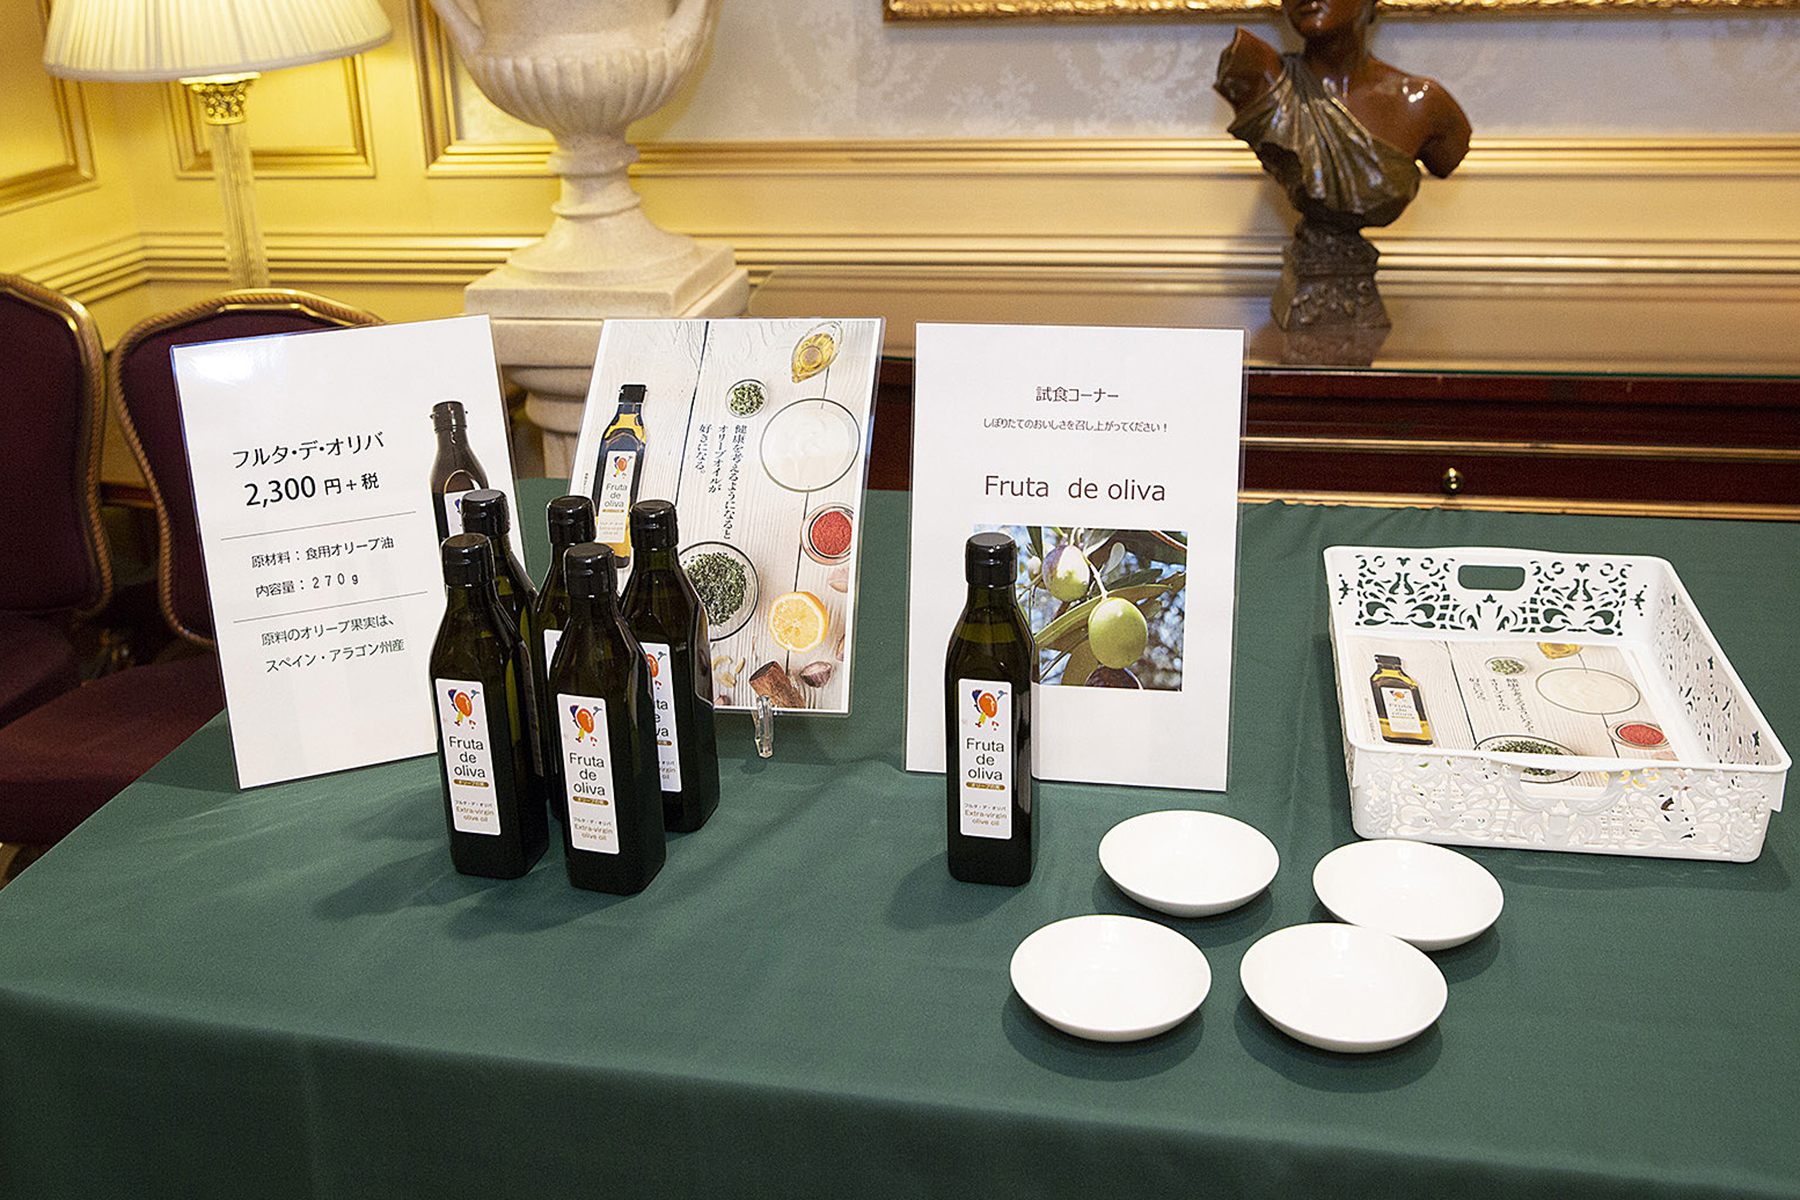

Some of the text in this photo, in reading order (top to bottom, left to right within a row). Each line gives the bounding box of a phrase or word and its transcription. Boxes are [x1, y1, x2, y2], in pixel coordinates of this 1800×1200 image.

[1035, 386, 1119, 403] 試食コーナー
[233, 431, 384, 469] フルタ・デ・オリバ
[695, 423, 713, 475] 好きになる。
[708, 424, 729, 494] オリーブオイルが
[606, 483, 628, 491] Fruta
[723, 424, 748, 540] 健康を考えるようになると
[985, 475, 1165, 501] Fruta de oliva
[244, 475, 316, 508] 2,300
[604, 500, 624, 508] oliva
[261, 614, 395, 646] 原料のオリーブ果実は、
[266, 638, 405, 673] スペイン・アラゴン州産
[449, 736, 484, 751] Fruta
[966, 738, 1005, 753] Fruta
[460, 751, 477, 764] de
[569, 752, 605, 768] Fruta
[976, 753, 995, 766] de
[454, 765, 486, 779] oliva
[579, 769, 597, 781] de
[968, 768, 1003, 781] oliva
[573, 783, 606, 797] oliva
[581, 832, 597, 840] olive
